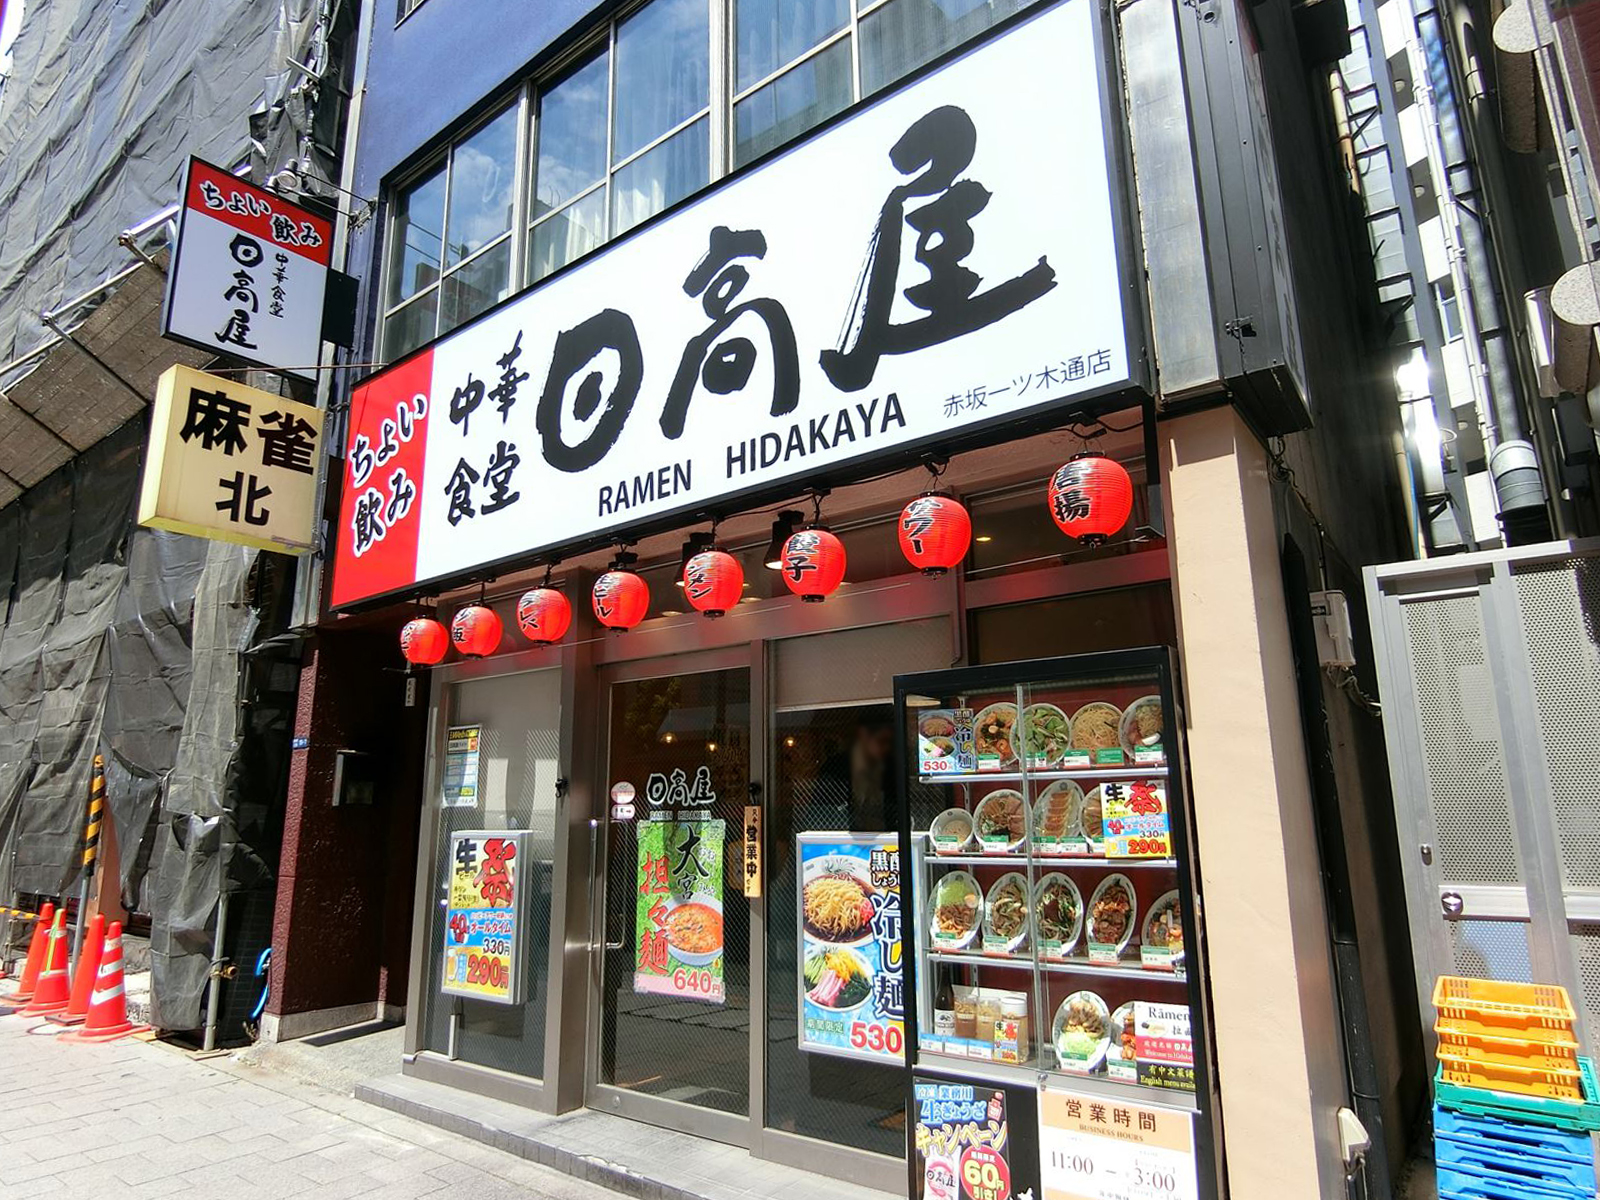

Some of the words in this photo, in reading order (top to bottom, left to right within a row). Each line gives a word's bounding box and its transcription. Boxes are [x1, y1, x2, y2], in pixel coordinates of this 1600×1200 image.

[200, 181, 322, 248] ちょい飲み
[214, 233, 264, 350] 日高屋
[269, 253, 290, 319] 中華食堂
[536, 105, 1057, 472] 日高屋
[449, 330, 529, 437] 中華
[943, 349, 1111, 418] 赤坂一ツ木通店
[179, 387, 318, 476] 麻雀
[350, 393, 428, 490] ちょい
[599, 459, 692, 517] RAMEN
[726, 393, 906, 478] HIDAKAYA
[216, 470, 272, 527] 北
[352, 467, 416, 558] 飲み
[444, 442, 520, 527] 食堂
[785, 532, 819, 582] 餃子
[646, 766, 717, 806] 日高屋
[1105, 779, 1125, 803] 生
[456, 838, 477, 875] 生
[672, 824, 710, 900] 大宮
[746, 825, 758, 878] 営業中
[1128, 839, 1167, 854] 290円
[916, 1121, 1007, 1157] キャンペーン
[1066, 1099, 1156, 1132] 営業時間
[1079, 1124, 1116, 1137] BUSINESS
[1117, 1130, 1144, 1142] HOURS
[1052, 1151, 1094, 1175] 11:00
[1134, 1167, 1175, 1192] 3:00
